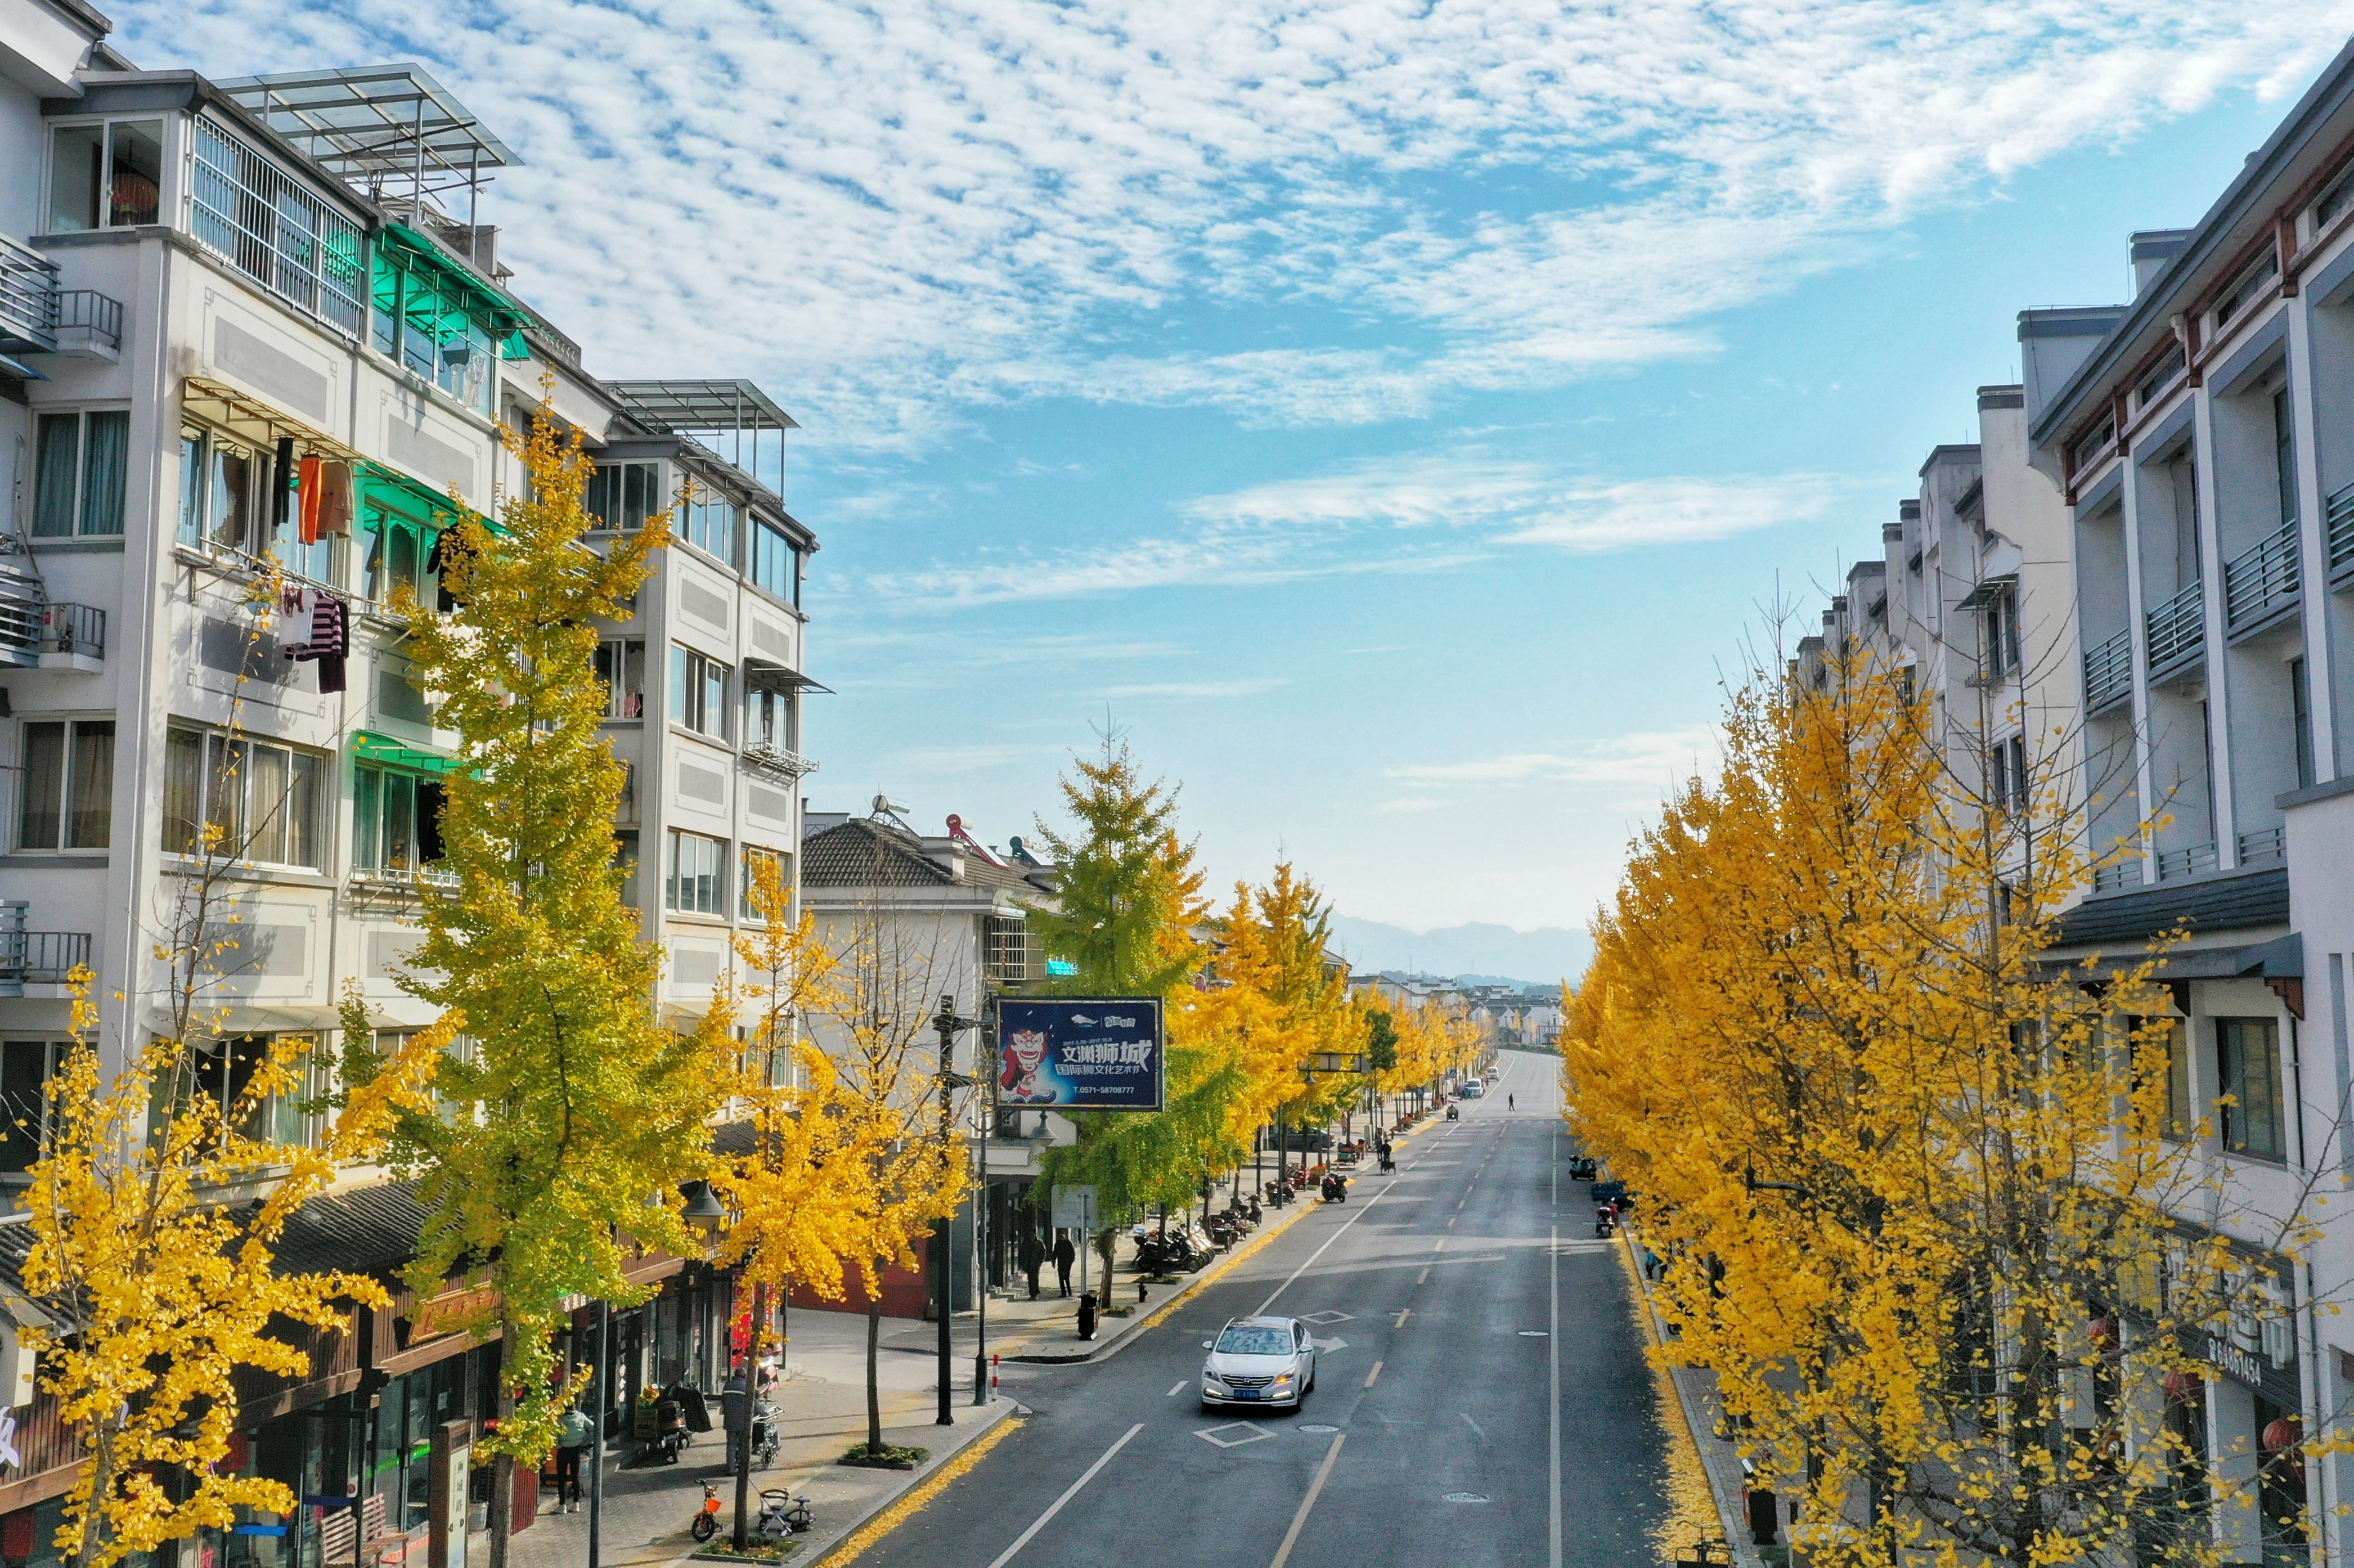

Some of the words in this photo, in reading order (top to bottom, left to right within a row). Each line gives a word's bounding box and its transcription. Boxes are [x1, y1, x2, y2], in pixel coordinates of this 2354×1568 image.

[1062, 1039, 1153, 1072] 文渊狮城
[1055, 1063, 1140, 1076] 国际狮文化艺术节
